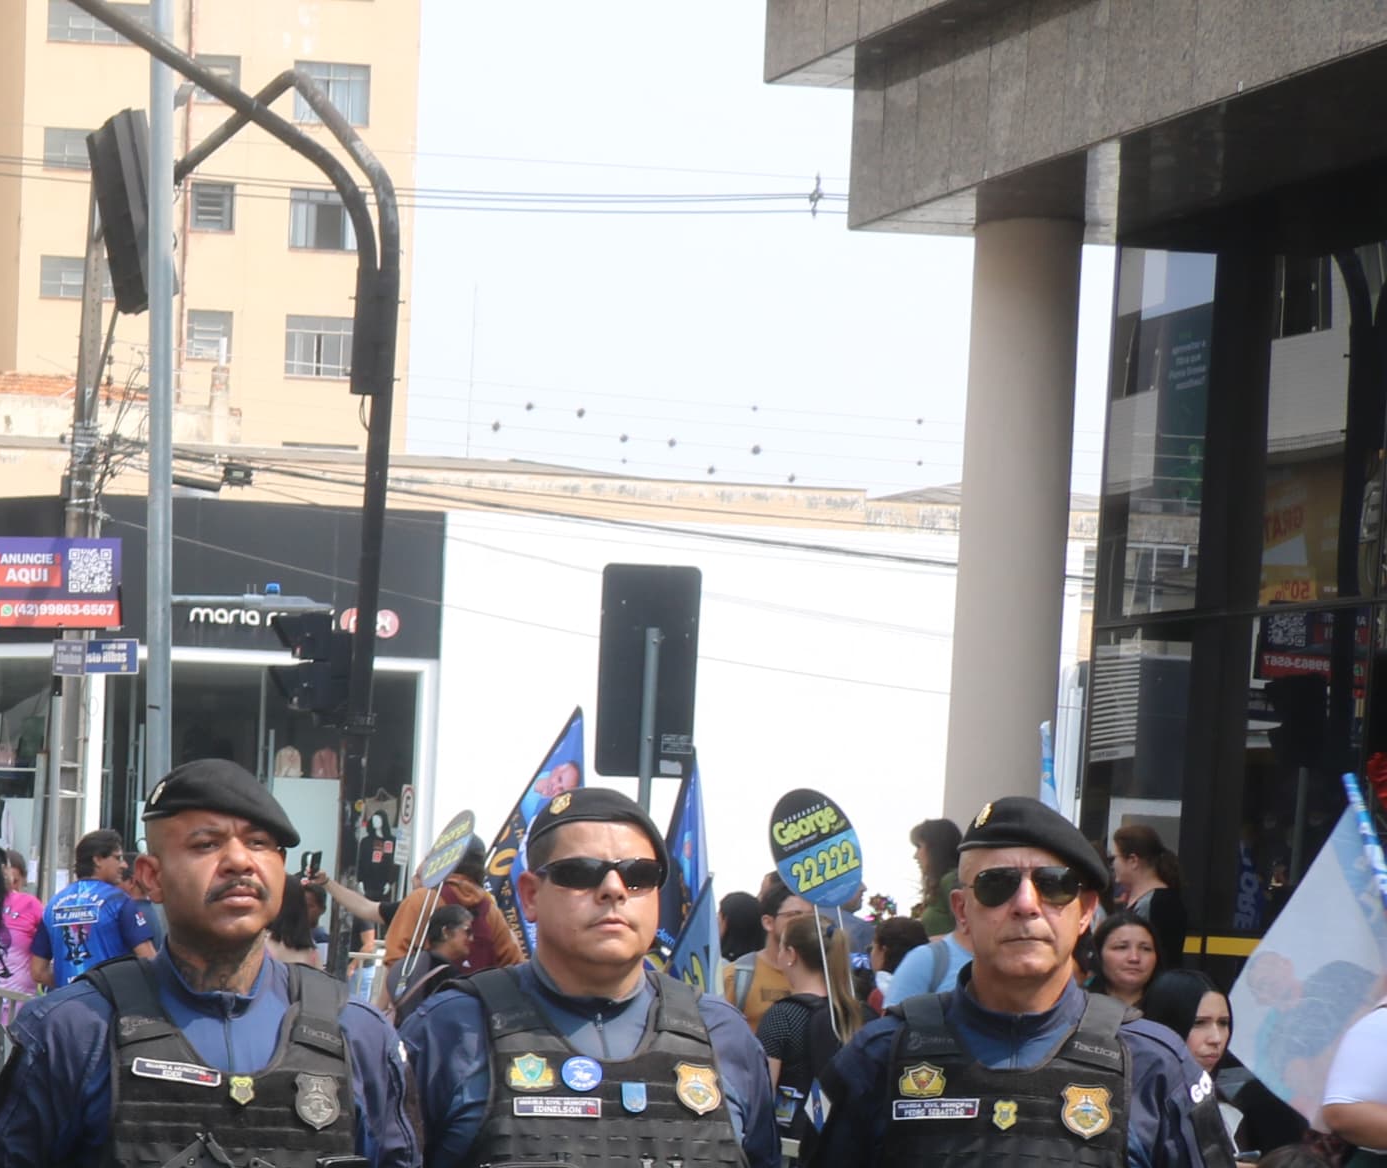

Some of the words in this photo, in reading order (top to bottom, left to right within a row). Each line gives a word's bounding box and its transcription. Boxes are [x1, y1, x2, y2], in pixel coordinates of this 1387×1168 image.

[0, 553, 54, 565] ANUNCIE
[5, 569, 48, 584] AQUI
[189, 607, 260, 626] maria
[772, 806, 838, 846] George
[533, 1104, 582, 1113] EDINELSON
